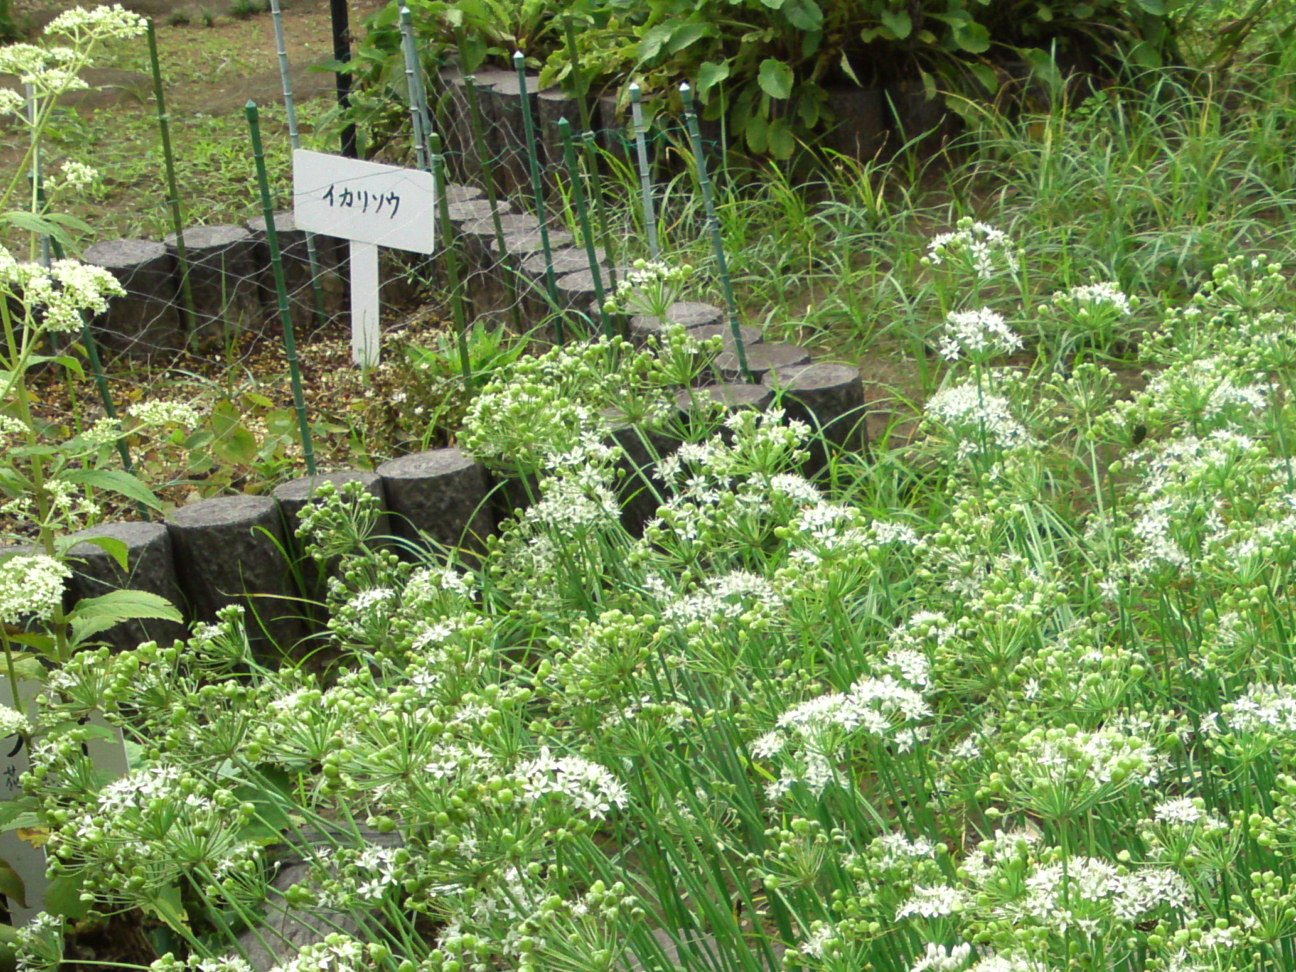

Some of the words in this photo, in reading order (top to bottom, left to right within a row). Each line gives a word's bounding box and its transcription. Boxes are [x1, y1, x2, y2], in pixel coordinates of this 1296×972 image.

[322, 183, 401, 220] イカリソウ
